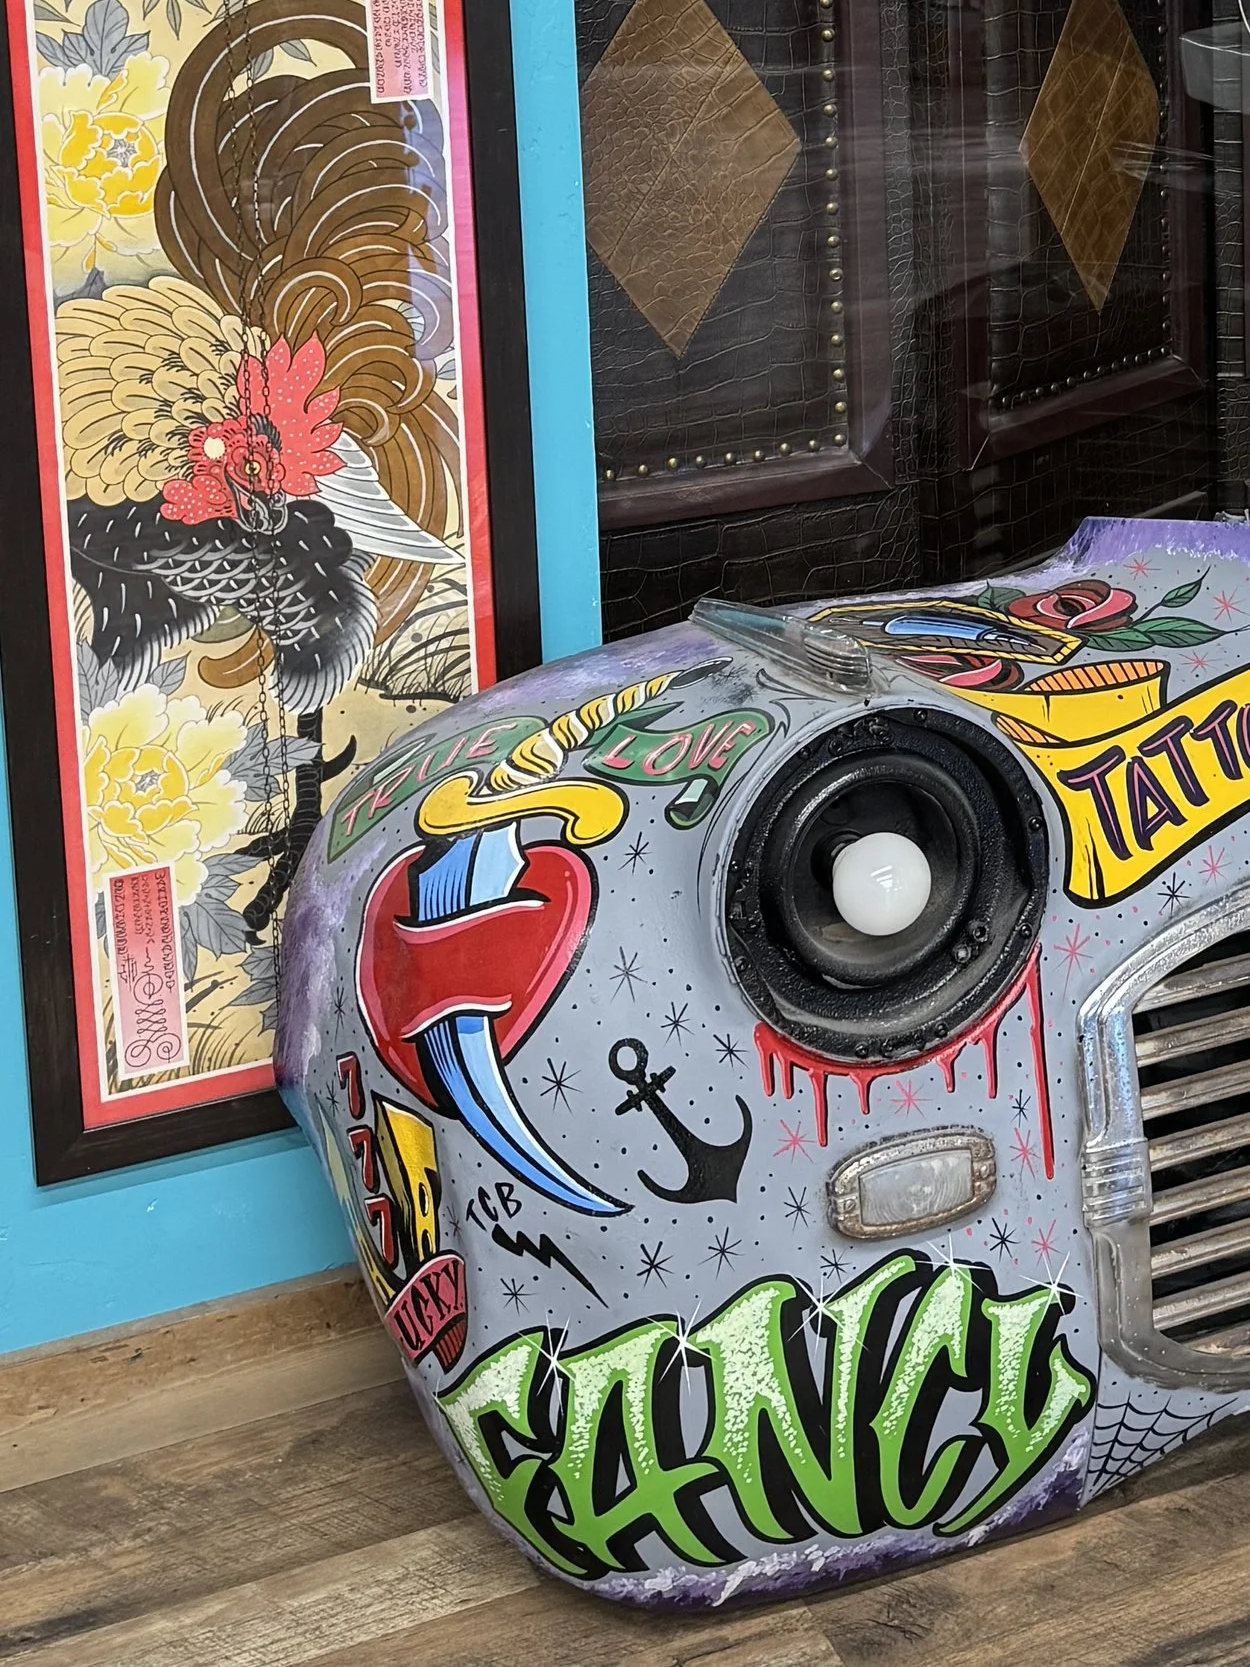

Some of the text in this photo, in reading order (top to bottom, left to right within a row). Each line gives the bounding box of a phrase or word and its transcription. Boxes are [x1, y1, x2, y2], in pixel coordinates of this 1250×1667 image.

[341, 720, 757, 836] TRUE LOVE
[466, 1182, 522, 1231] TCB
[394, 1260, 461, 1350] UCKY
[437, 1255, 1091, 1574] FANCY
